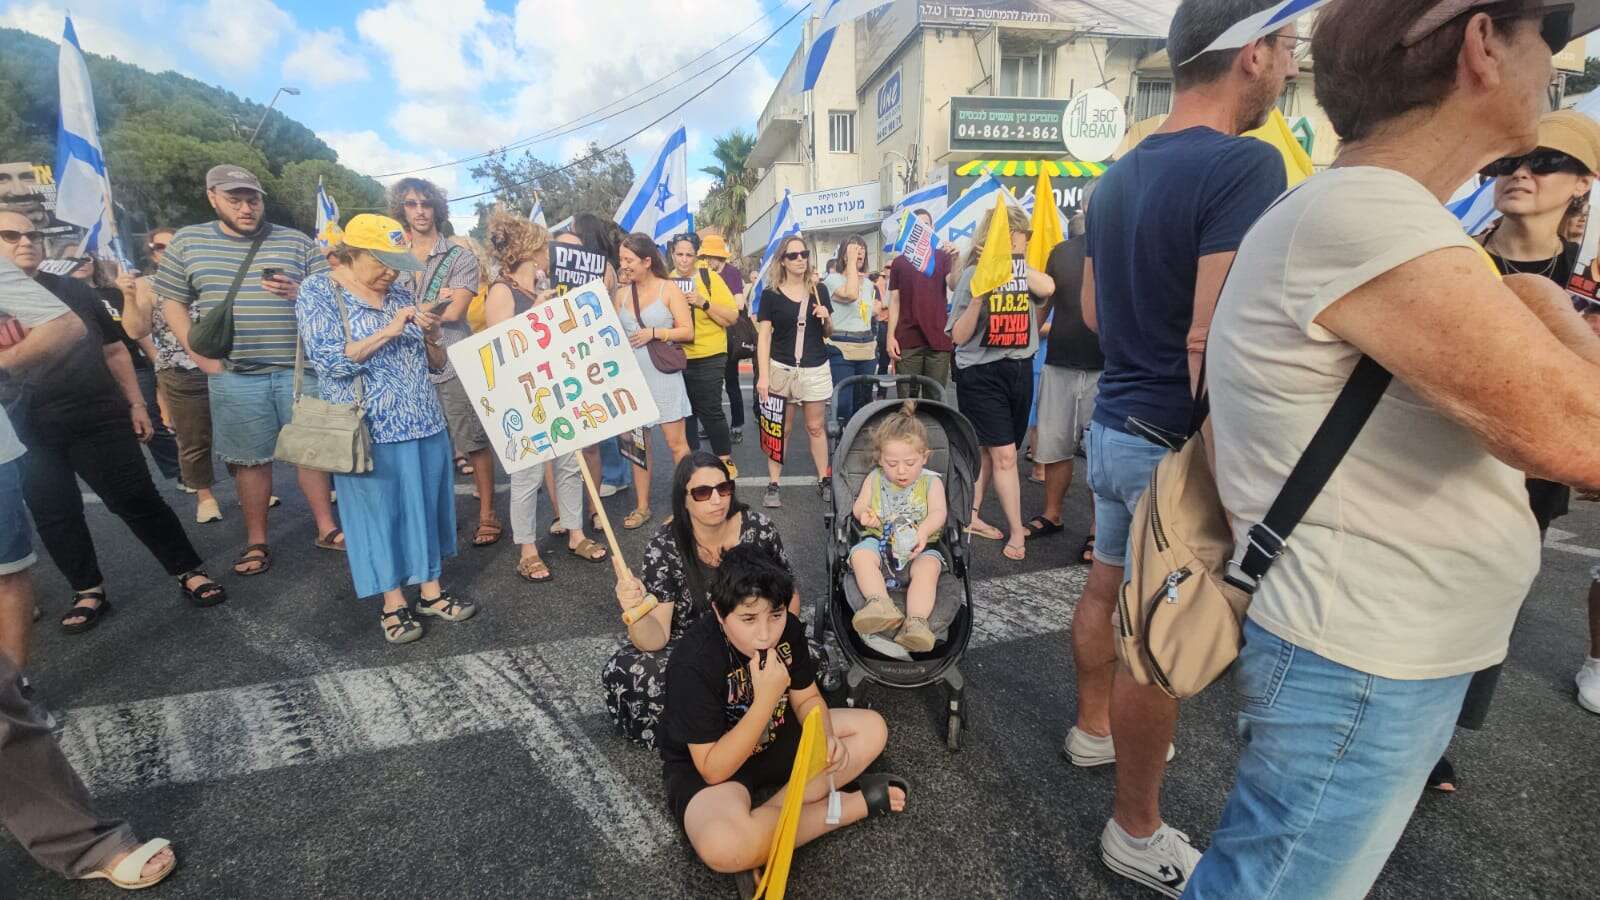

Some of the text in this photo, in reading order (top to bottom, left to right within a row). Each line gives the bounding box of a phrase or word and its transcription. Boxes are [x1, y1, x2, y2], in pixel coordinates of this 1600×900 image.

[950, 6, 975, 18] בלבד
[977, 8, 1019, 20] להמחשה
[1021, 12, 1050, 22] הדמיה
[958, 124, 1058, 139] 04-862-2-862
[818, 190, 850, 201] בית מרקחת
[806, 199, 864, 216] מעוז פארם
[556, 246, 606, 273] עוצרים
[555, 269, 587, 284] הטירוף
[989, 294, 1029, 312] 17.8.25
[990, 314, 1029, 333] עוצרים
[478, 290, 603, 391] הניצחון
[988, 332, 1028, 345] את ישראל
